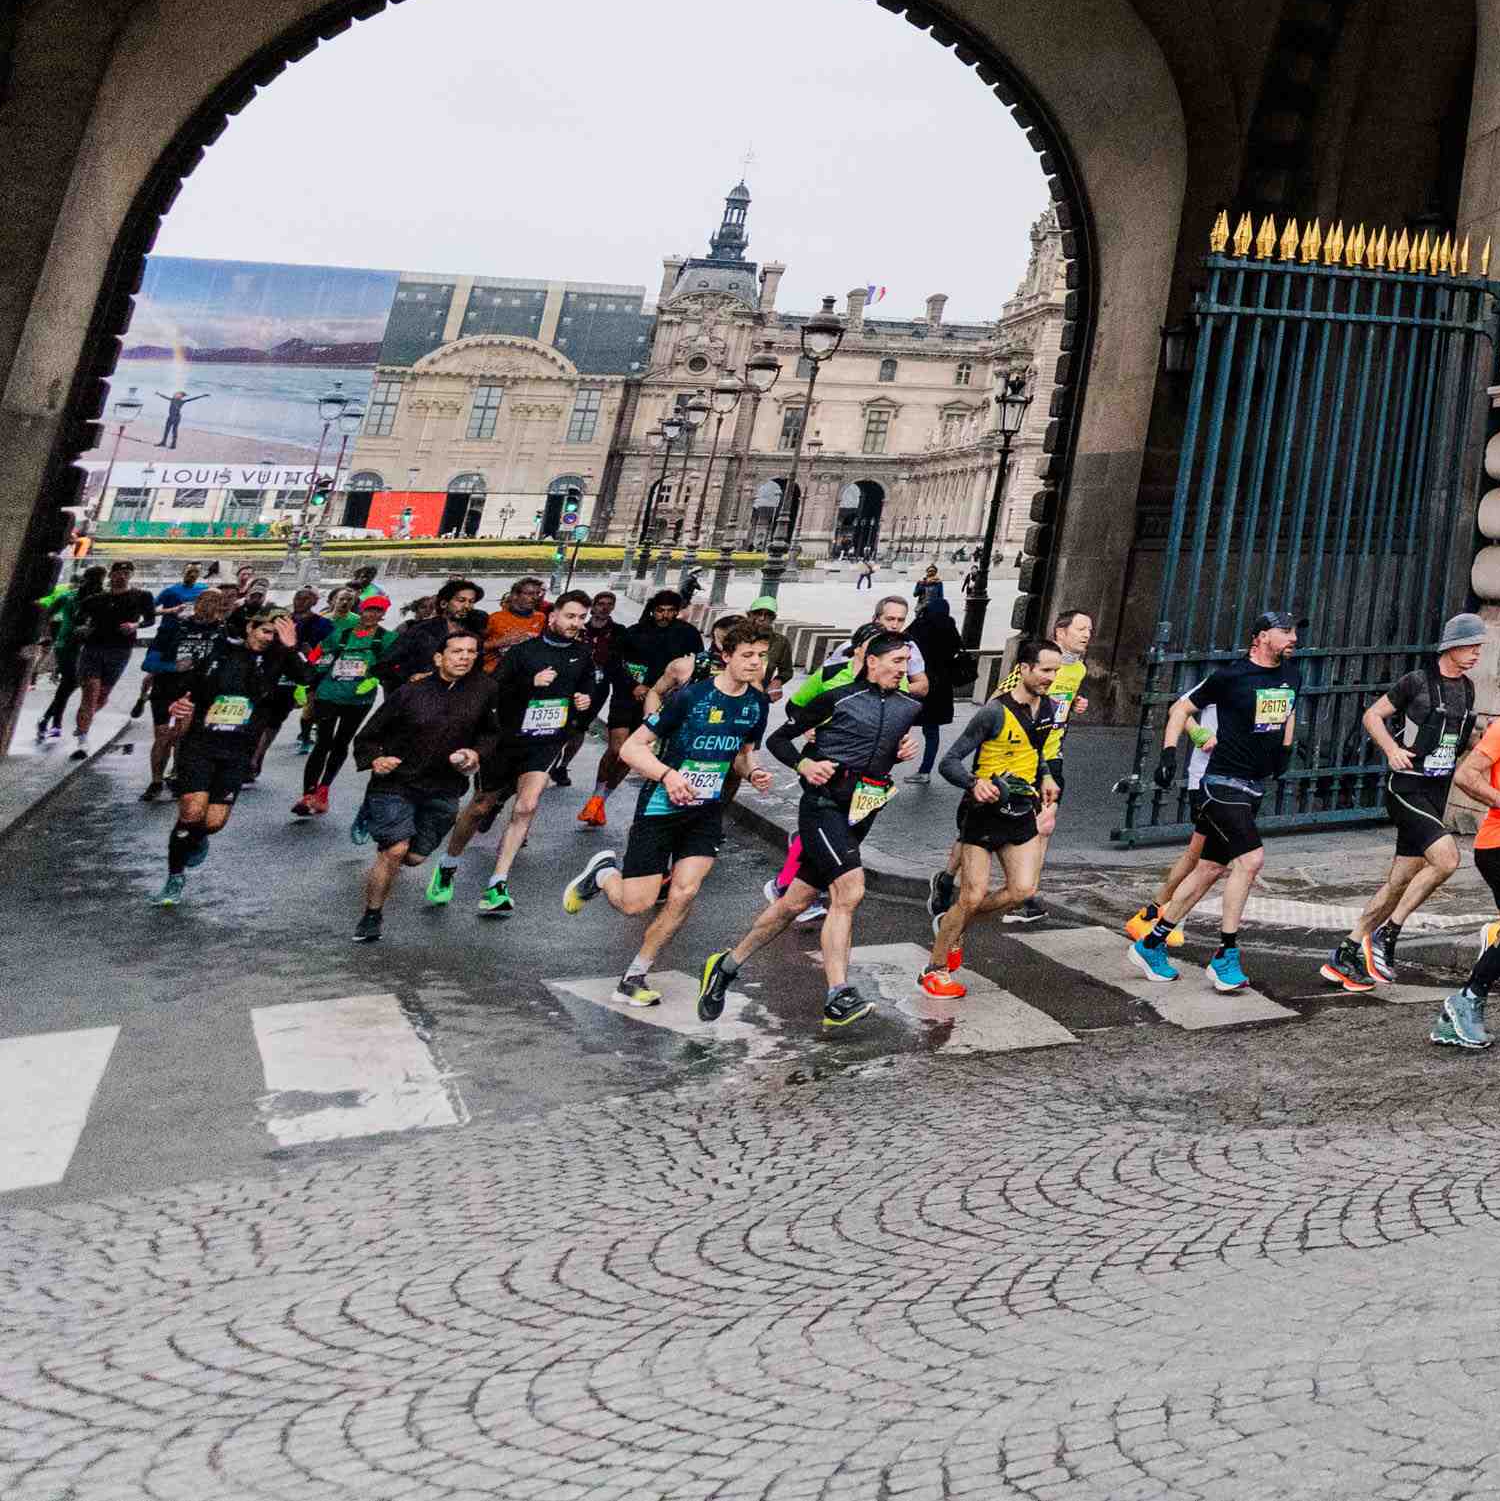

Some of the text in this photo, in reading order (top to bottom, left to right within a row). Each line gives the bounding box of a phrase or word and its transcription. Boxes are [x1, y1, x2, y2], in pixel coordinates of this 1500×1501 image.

[161, 468, 331, 486] LOUIS VUITTO
[1262, 699, 1287, 713] 26179
[531, 708, 560, 721] 13755
